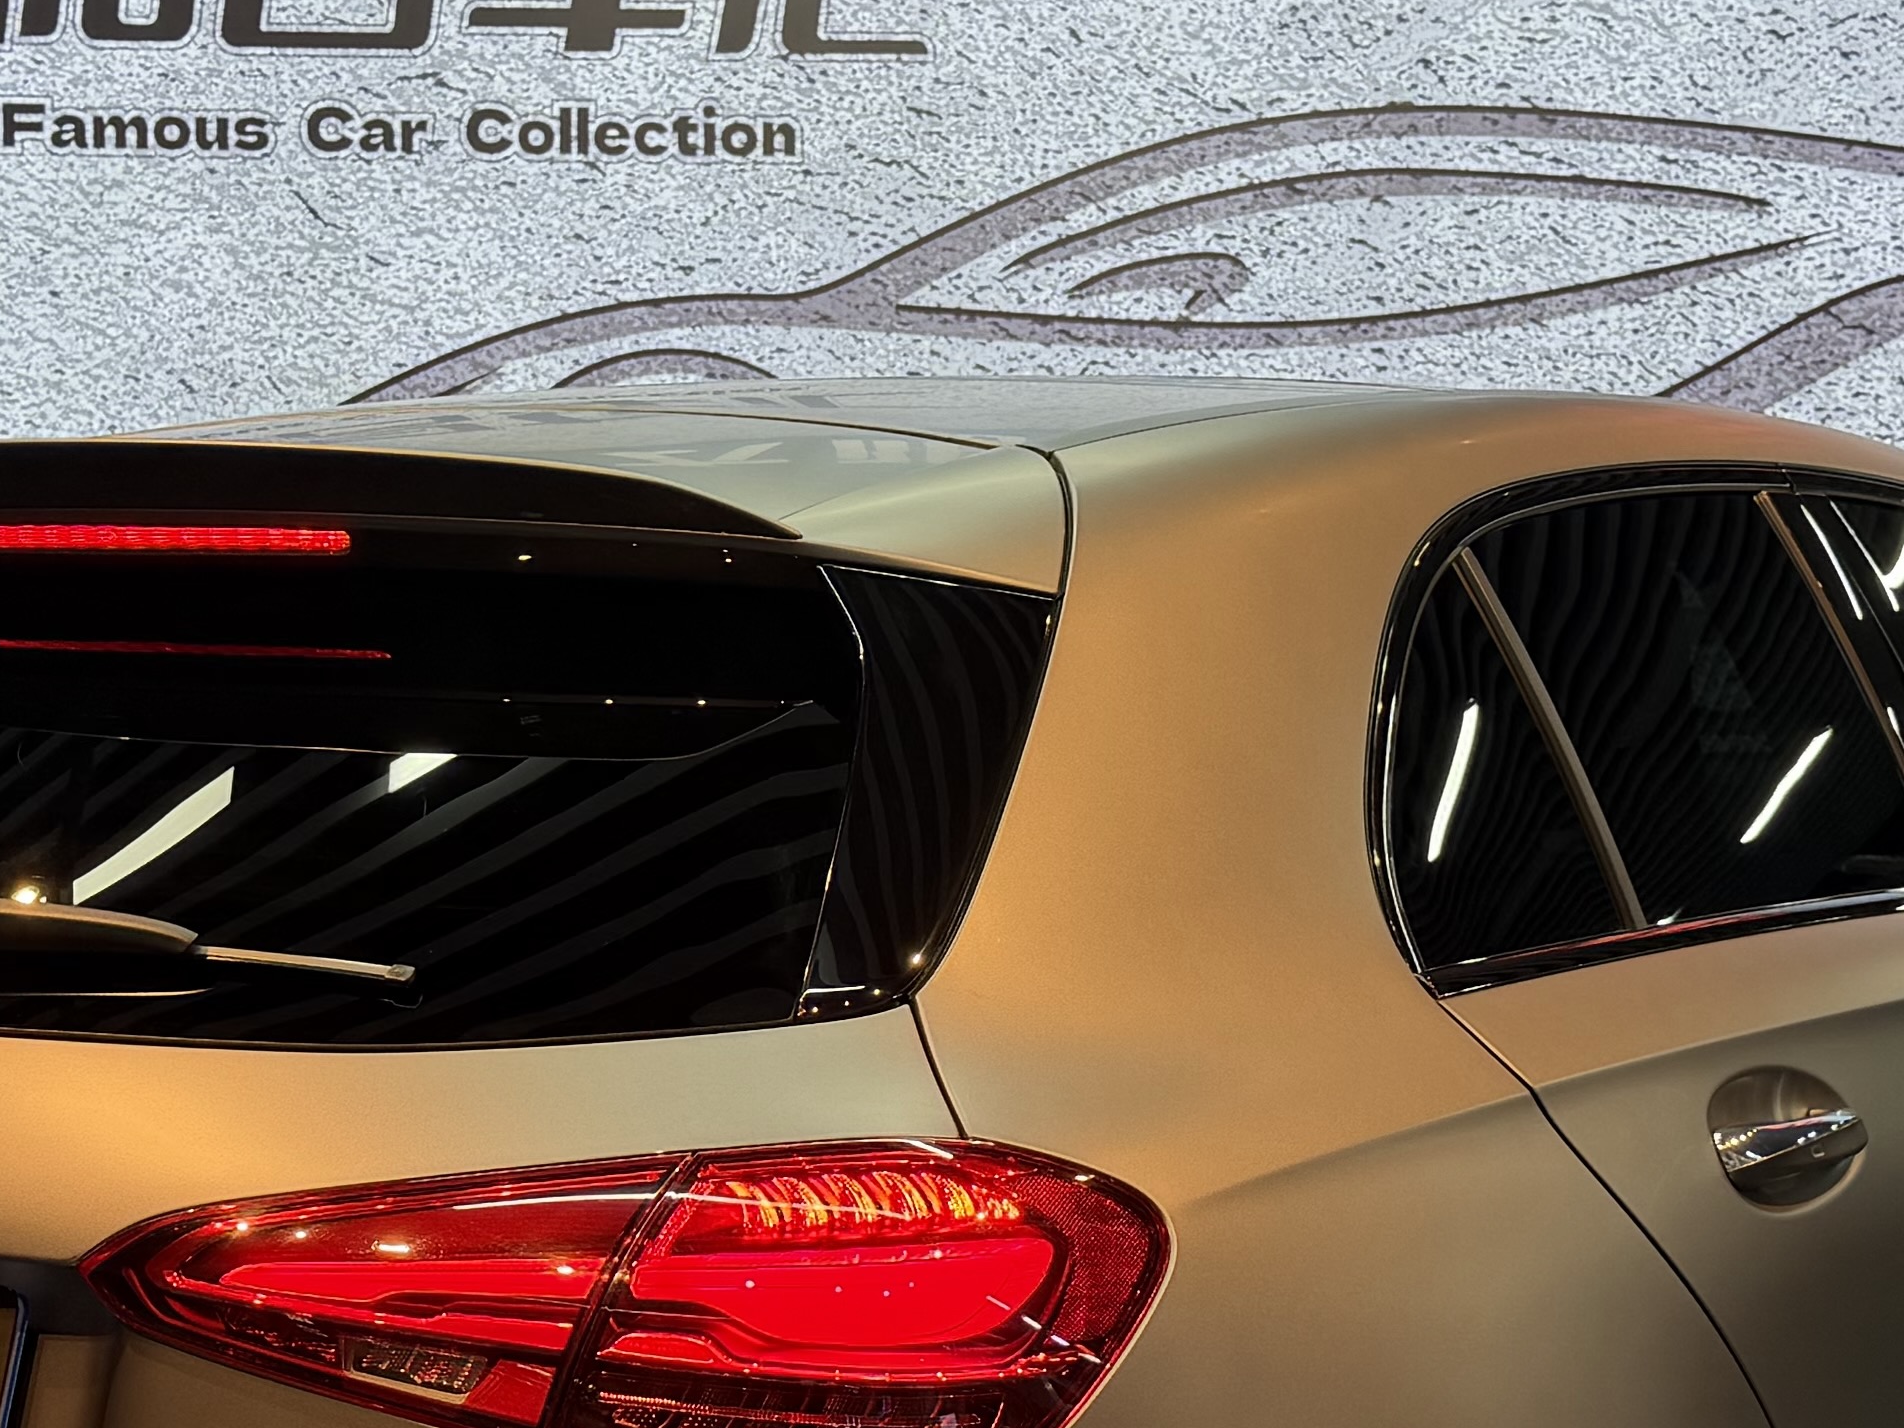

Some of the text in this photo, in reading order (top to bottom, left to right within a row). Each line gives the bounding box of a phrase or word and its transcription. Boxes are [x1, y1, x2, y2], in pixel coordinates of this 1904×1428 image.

[2, 102, 270, 153] Famous
[307, 105, 429, 156] Car
[465, 105, 797, 159] Collection
